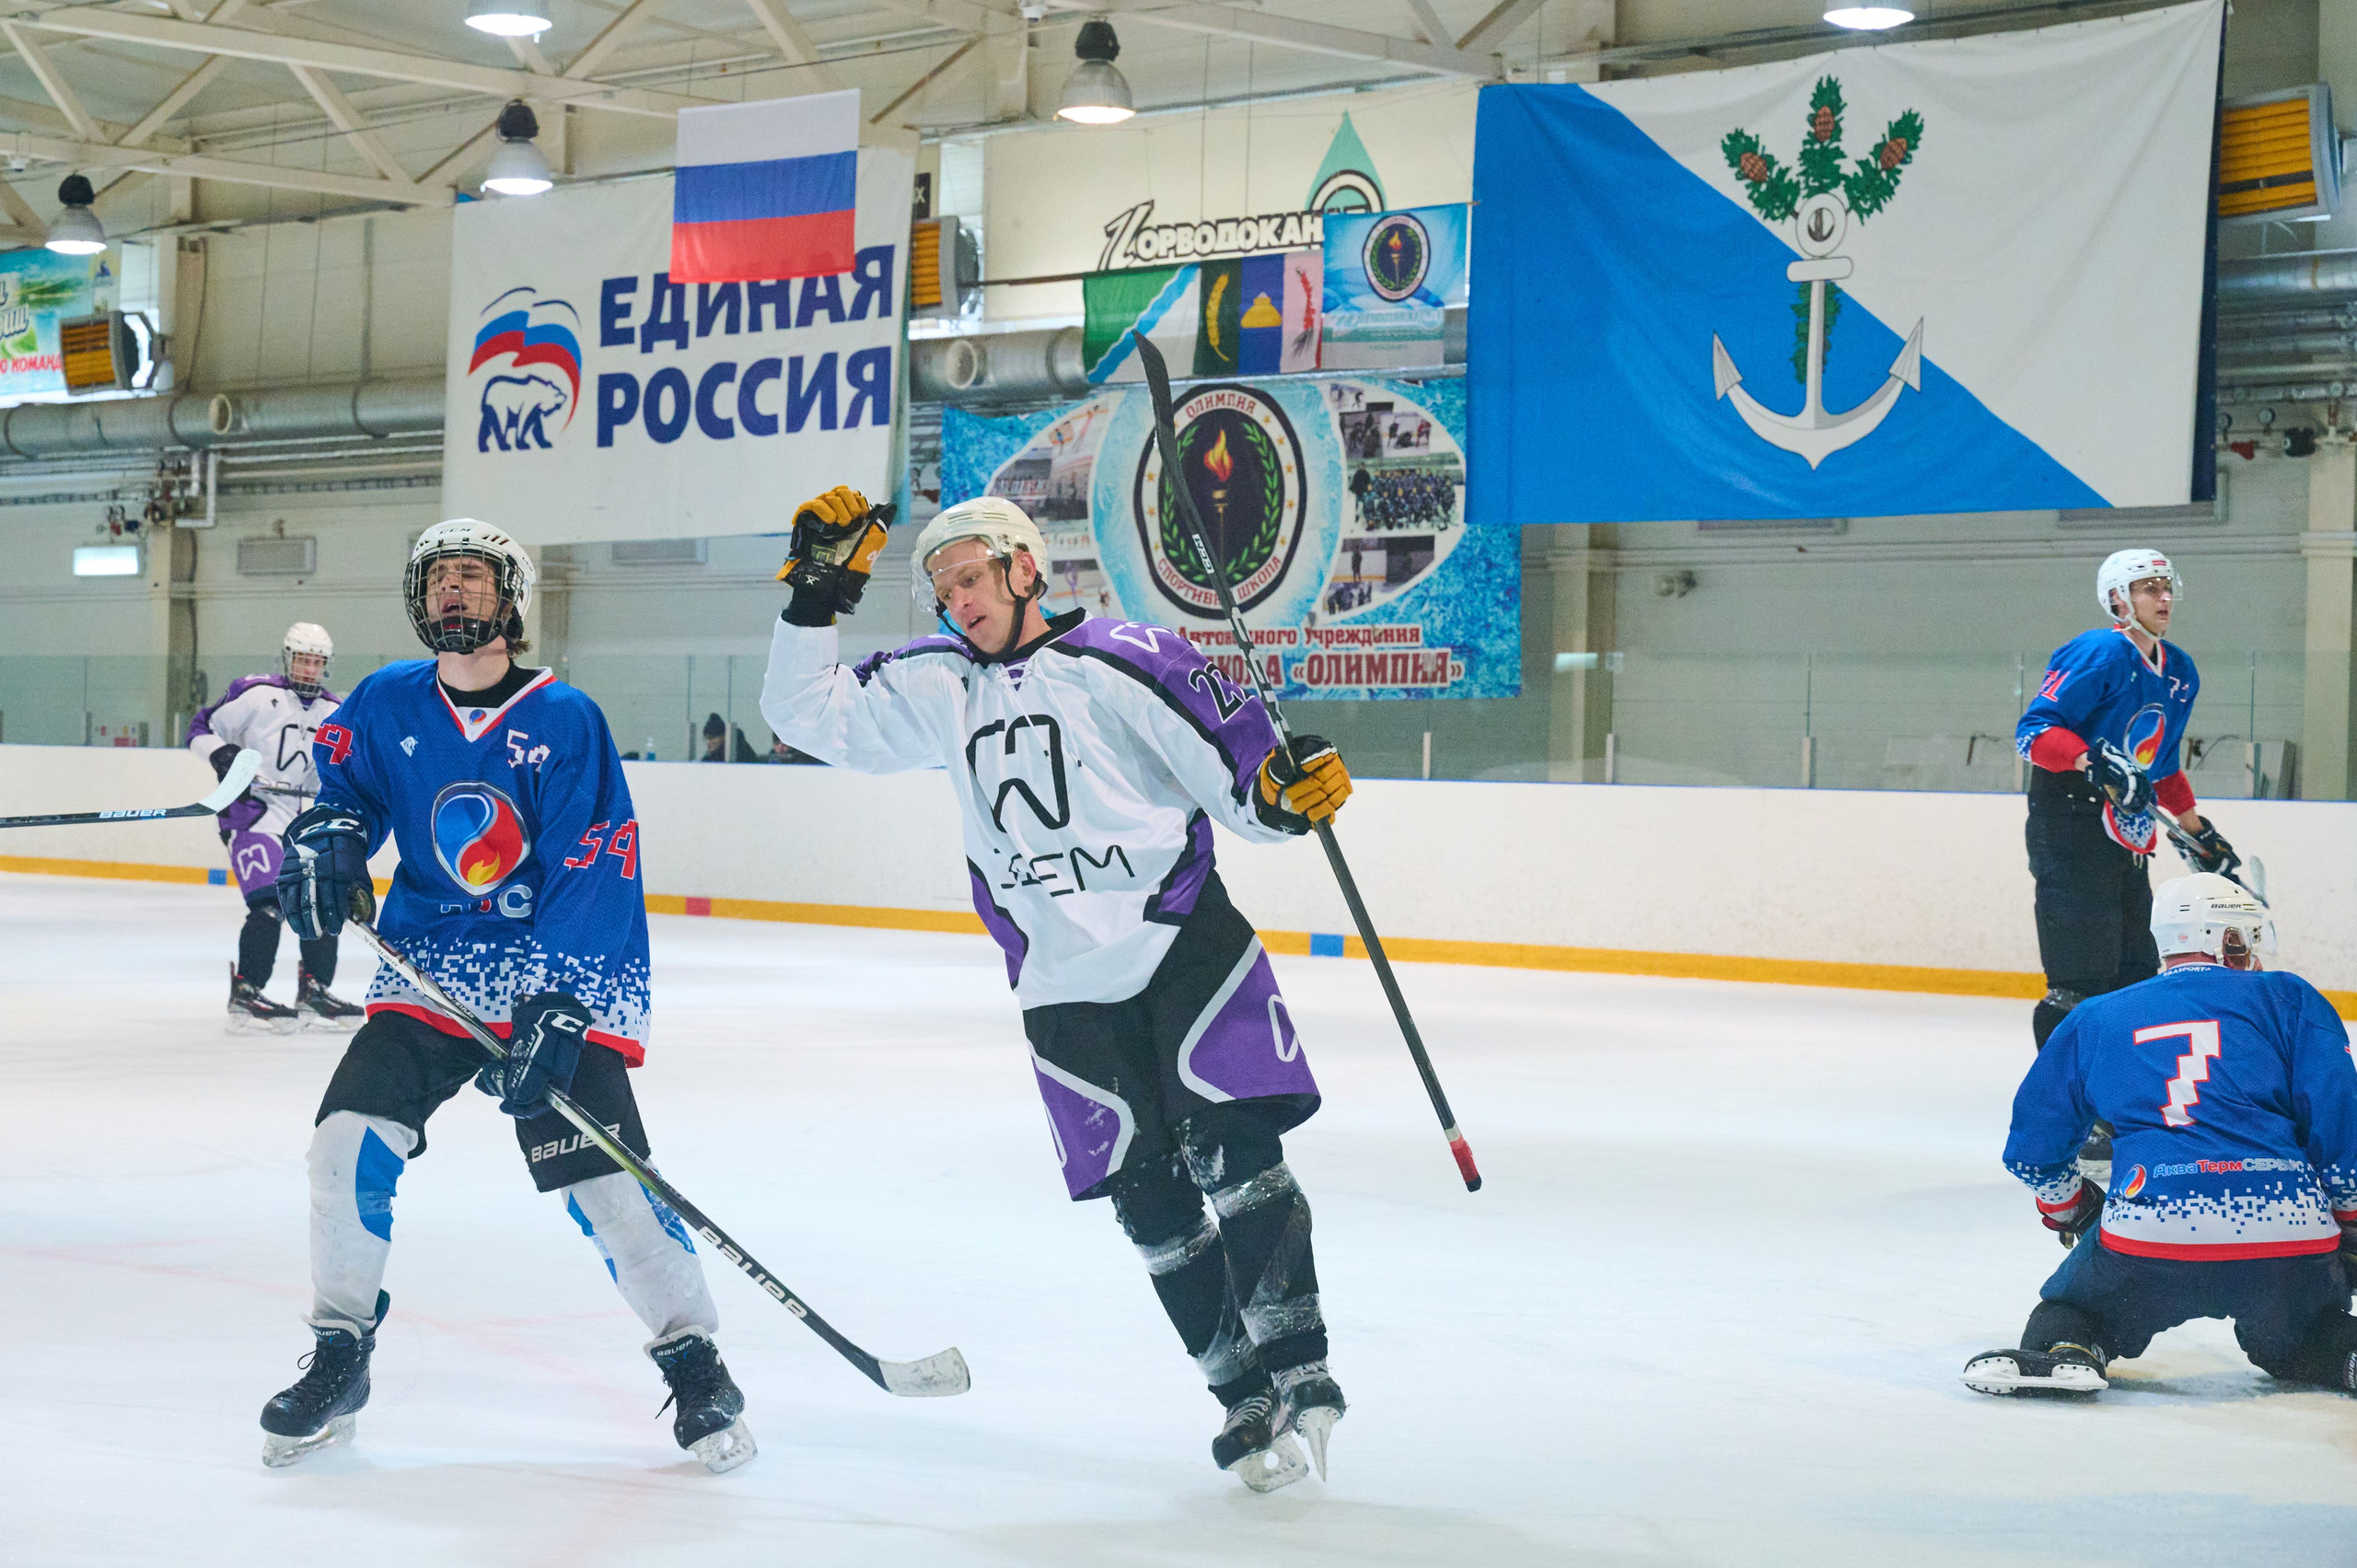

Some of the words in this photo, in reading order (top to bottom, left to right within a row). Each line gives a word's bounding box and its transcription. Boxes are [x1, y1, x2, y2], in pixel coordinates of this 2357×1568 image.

[1097, 199, 1368, 271] ГОРВОДОКАН
[599, 244, 896, 354] ЕДИНАЯ
[11, 354, 64, 374] КОМАНД
[597, 346, 892, 448] РОССИЯ
[1185, 392, 1257, 418] ОЛИМПИЯ
[1157, 558, 1222, 607] СПОРТИВ
[1237, 555, 1282, 600] ШКОЛА
[1178, 626, 1297, 645] Автонного
[99, 808, 168, 819] BAUER
[563, 819, 639, 880] 54
[2132, 1019, 2222, 1128] 7
[530, 1122, 621, 1164] BAUER
[698, 1225, 808, 1319] BAUER
[313, 1329, 341, 1337] AUER
[656, 1338, 694, 1357] BAUER
